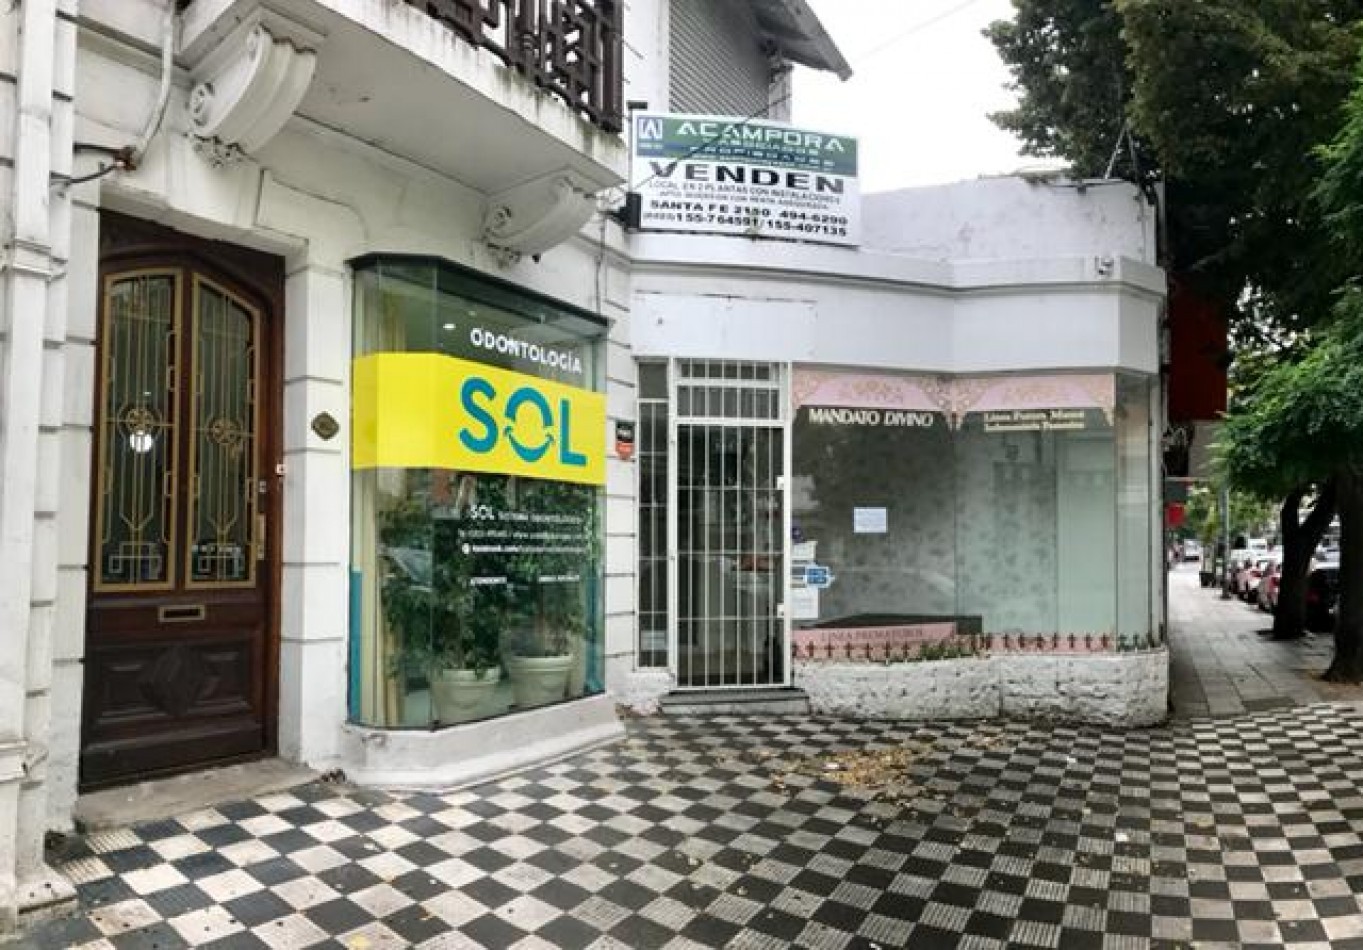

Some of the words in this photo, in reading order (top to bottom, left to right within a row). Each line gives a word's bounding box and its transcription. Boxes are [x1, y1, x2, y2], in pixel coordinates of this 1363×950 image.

[676, 120, 845, 152] ACAMPORA
[649, 161, 844, 194] VENDEN
[651, 200, 703, 212] SANTA
[709, 203, 729, 214] FE
[459, 377, 588, 467] SOL
[808, 408, 880, 426] MANDATO
[884, 410, 934, 427] DIVINO
[470, 504, 495, 520] SOL
